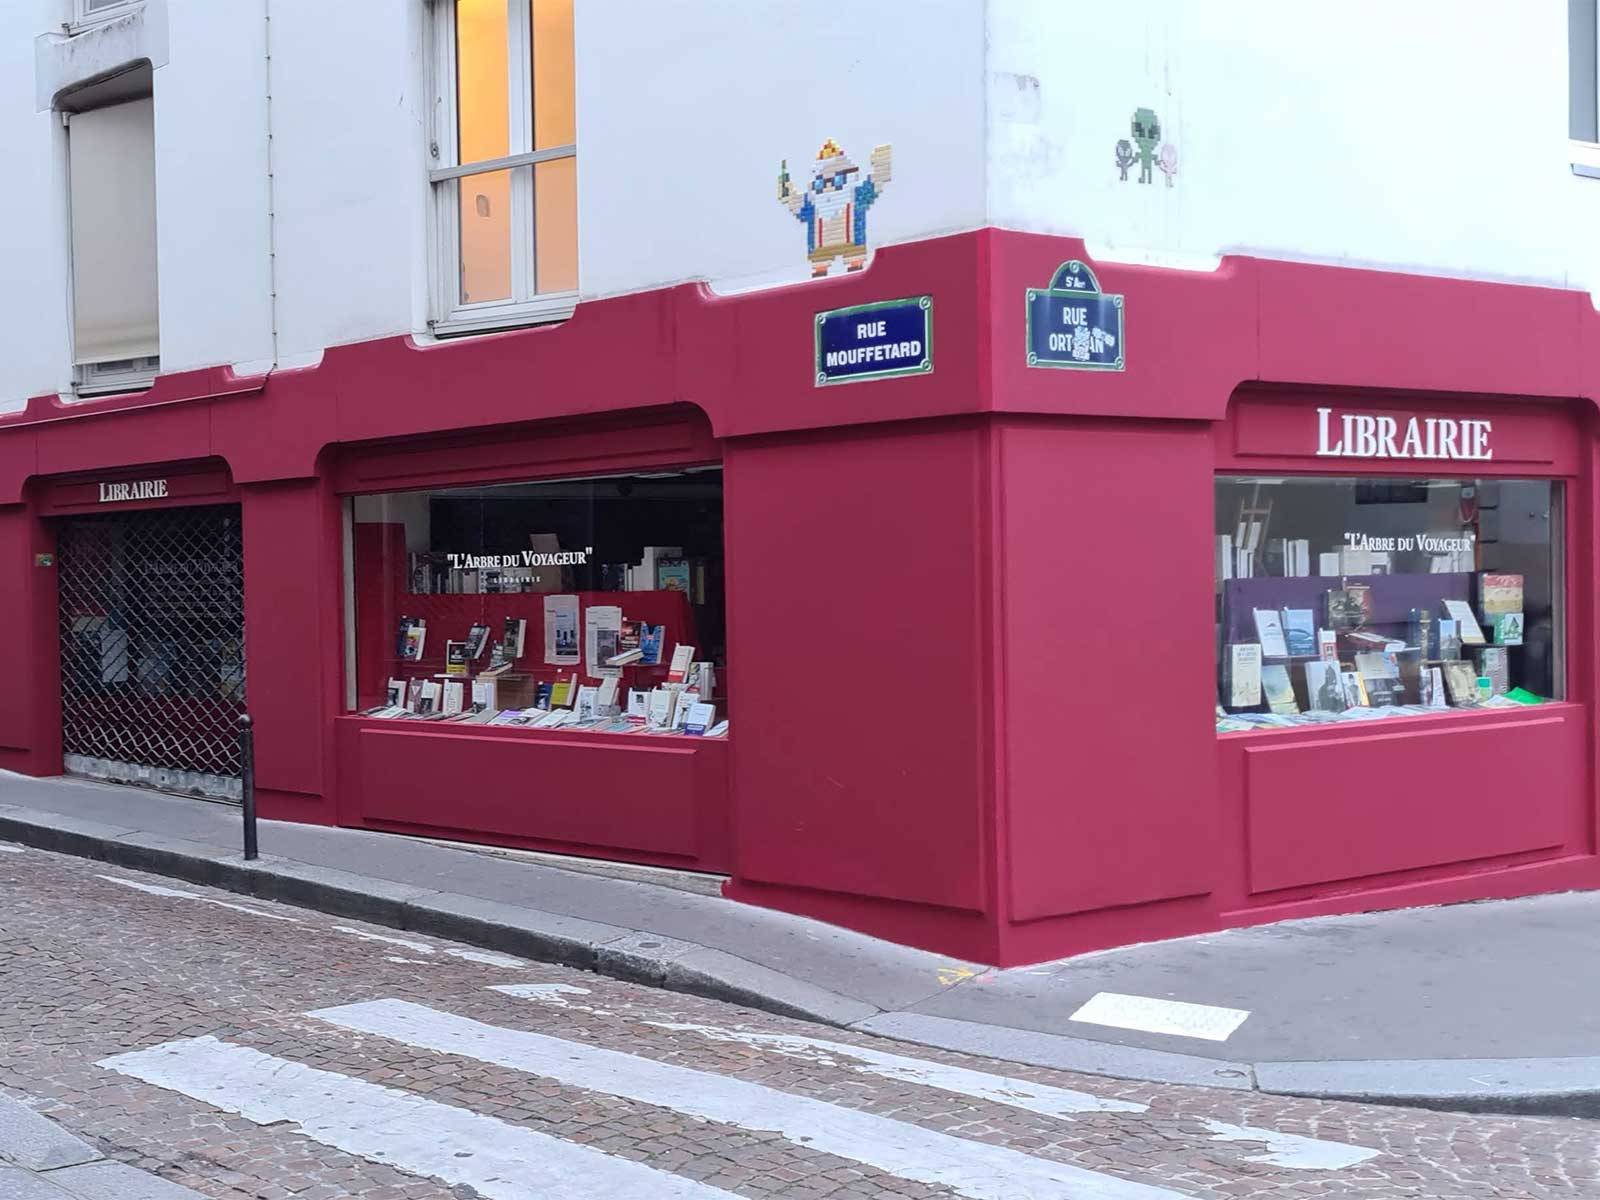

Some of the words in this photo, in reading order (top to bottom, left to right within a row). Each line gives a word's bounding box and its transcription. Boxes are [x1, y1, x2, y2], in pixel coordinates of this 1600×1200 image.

[1063, 307, 1088, 326] RUE
[857, 321, 887, 339] RUE
[1049, 333, 1104, 353] ORTAN
[826, 341, 921, 367] MOUFFETARD
[1316, 407, 1493, 460] LIBRAIRIE
[99, 480, 169, 502] LIBRAIRIE
[1397, 538, 1414, 551] DU
[502, 555, 520, 567] DU
